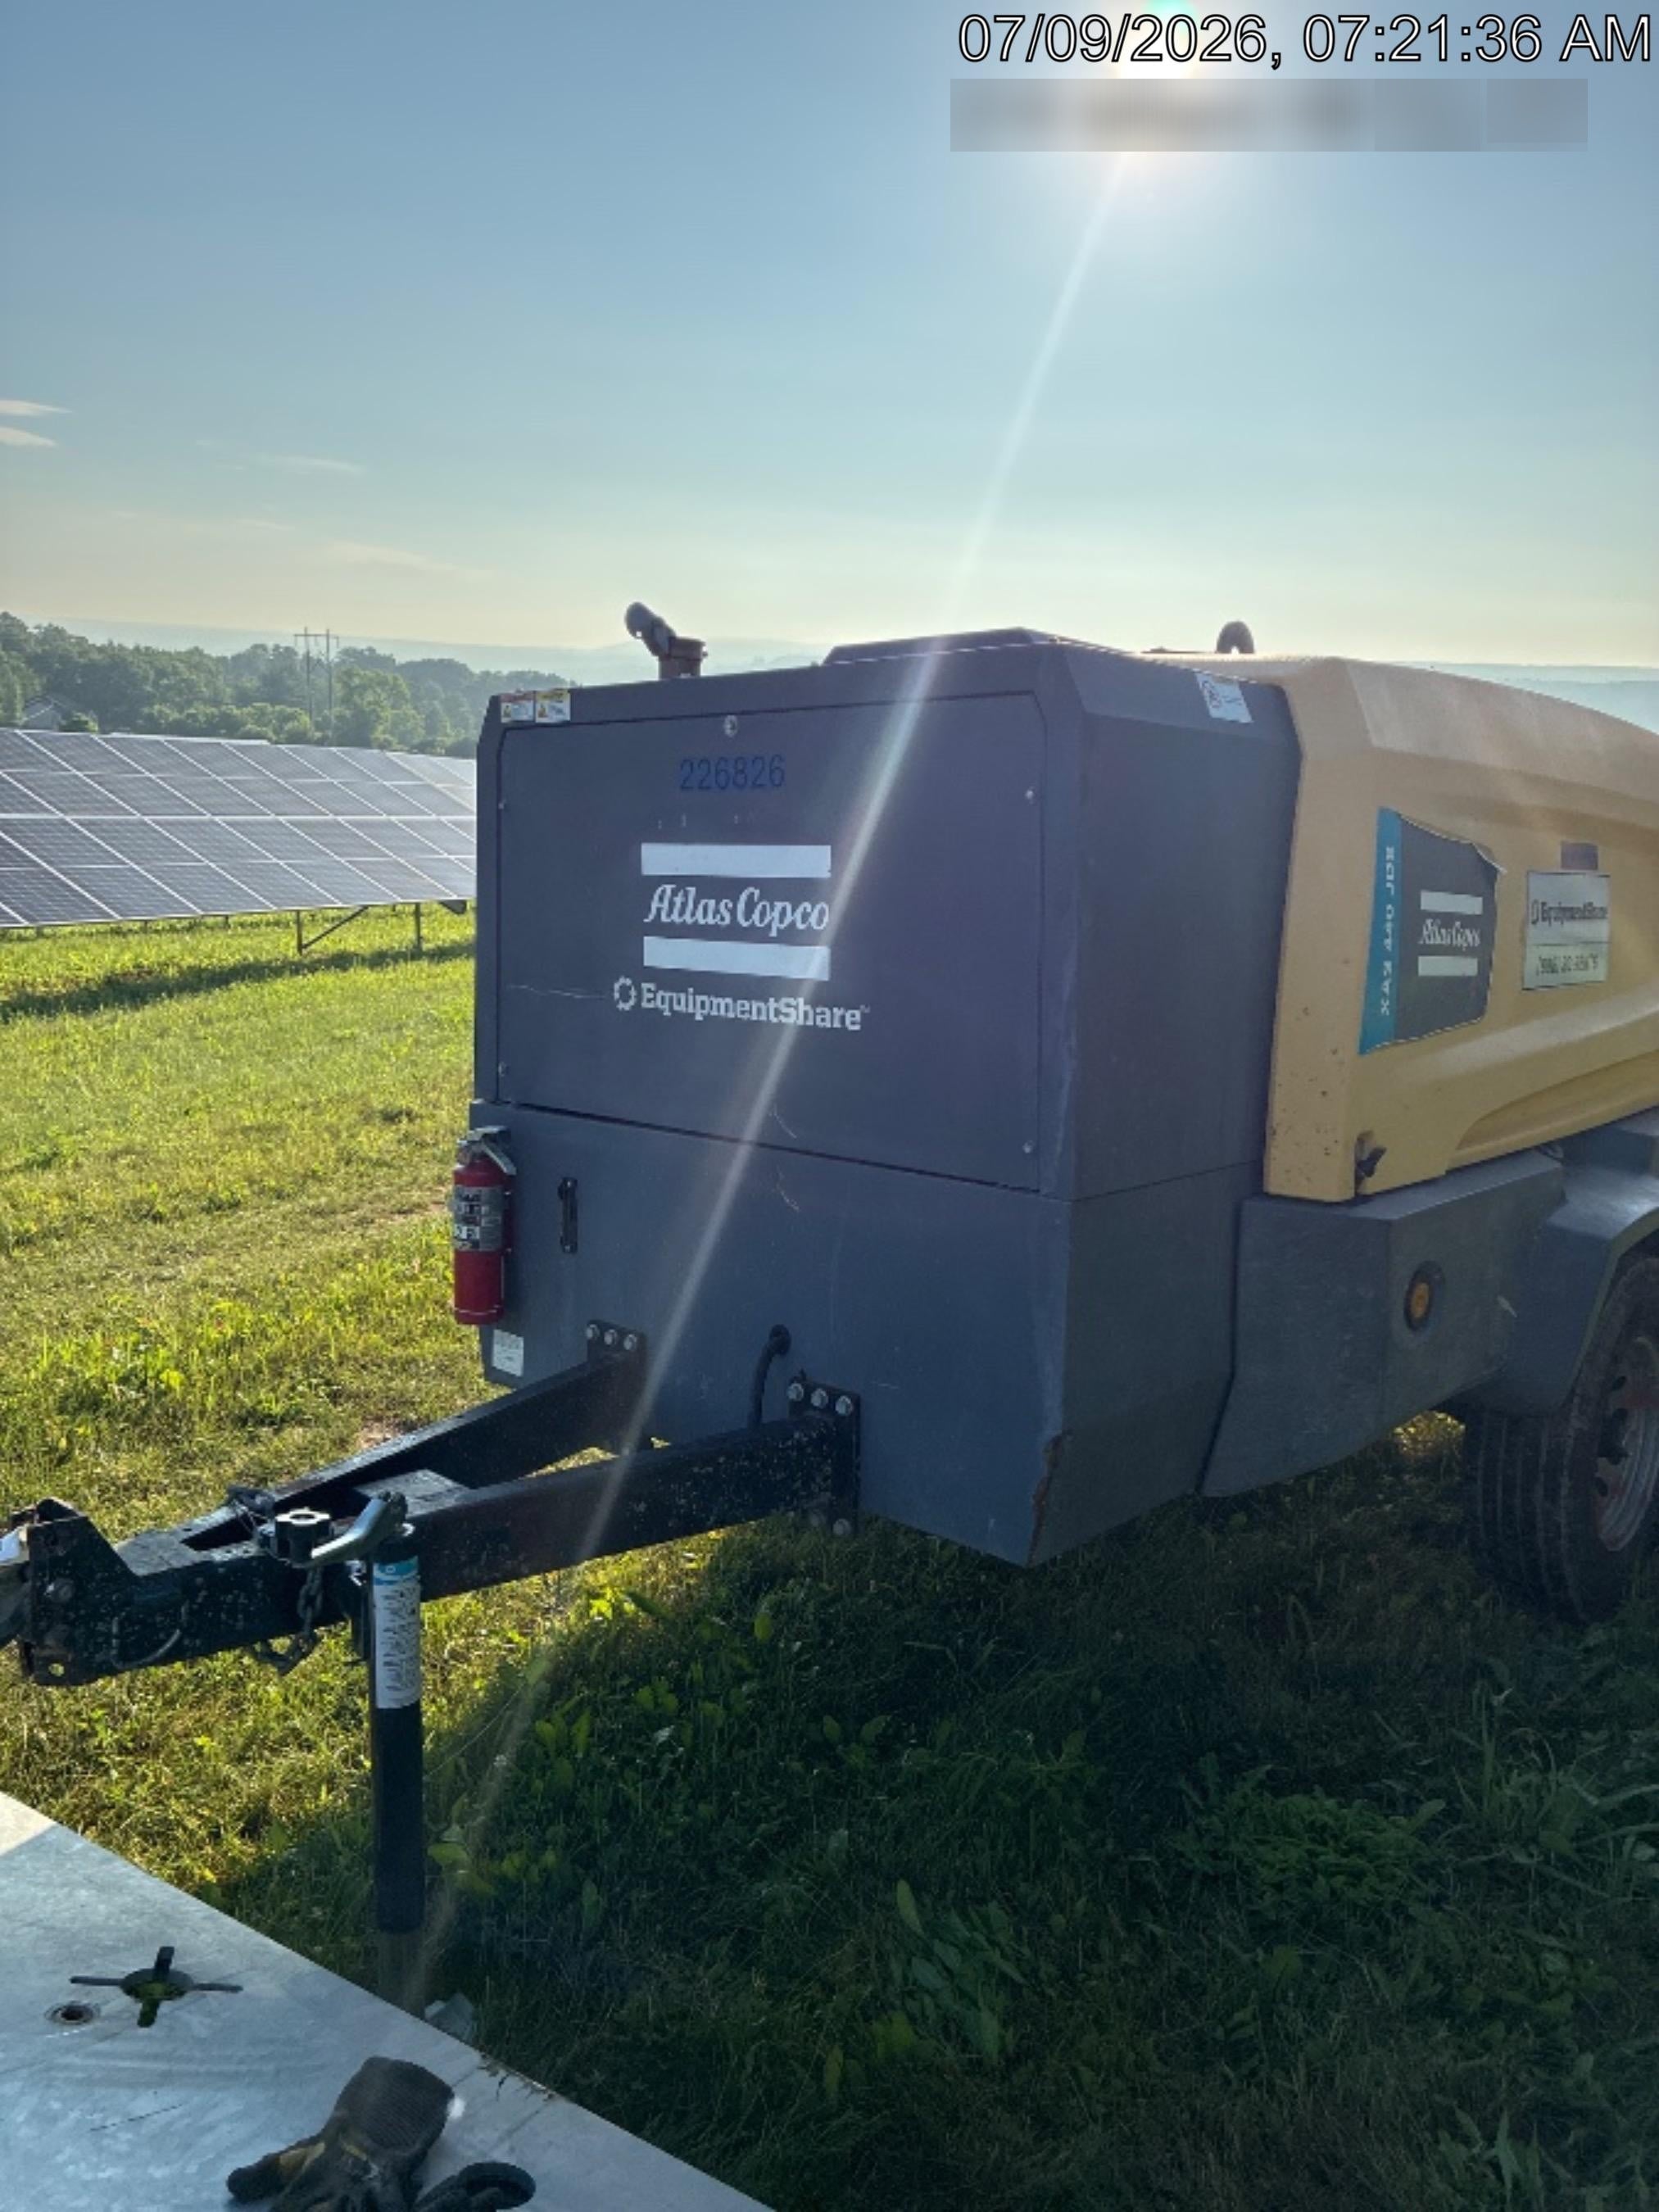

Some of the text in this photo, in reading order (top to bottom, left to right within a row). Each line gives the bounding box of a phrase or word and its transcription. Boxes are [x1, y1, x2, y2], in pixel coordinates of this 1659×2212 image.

[680, 754, 786, 791] 226826
[643, 884, 830, 937] Atlas Copco
[640, 982, 862, 1031] EquipmentShare
